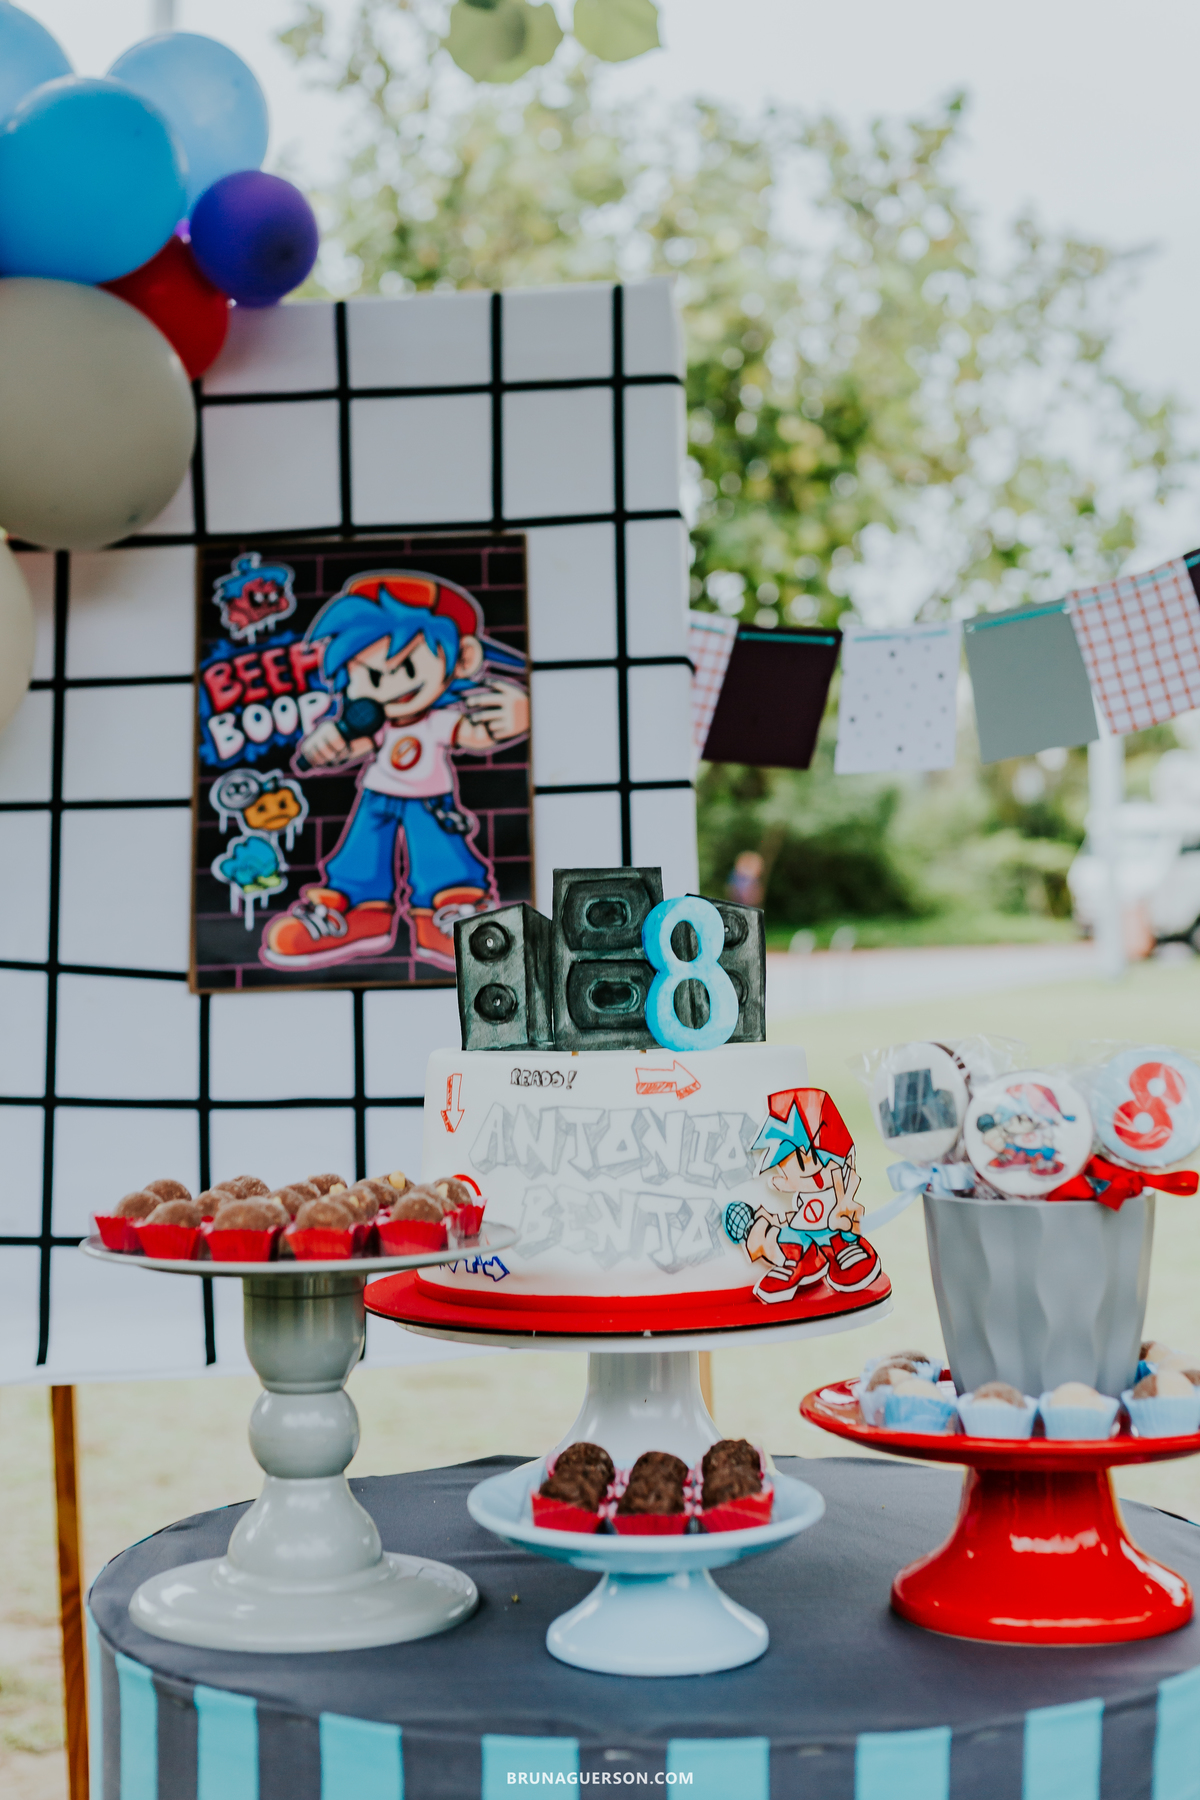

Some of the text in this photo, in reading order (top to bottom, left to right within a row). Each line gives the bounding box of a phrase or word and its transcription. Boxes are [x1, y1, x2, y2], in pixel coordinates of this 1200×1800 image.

[203, 638, 330, 713] BEEP
[208, 690, 331, 760] BOOP
[641, 895, 739, 1052] 8
[468, 1101, 760, 1190] ANTONIO
[1113, 1062, 1187, 1151] 8
[511, 1184, 725, 1275] BENTO
